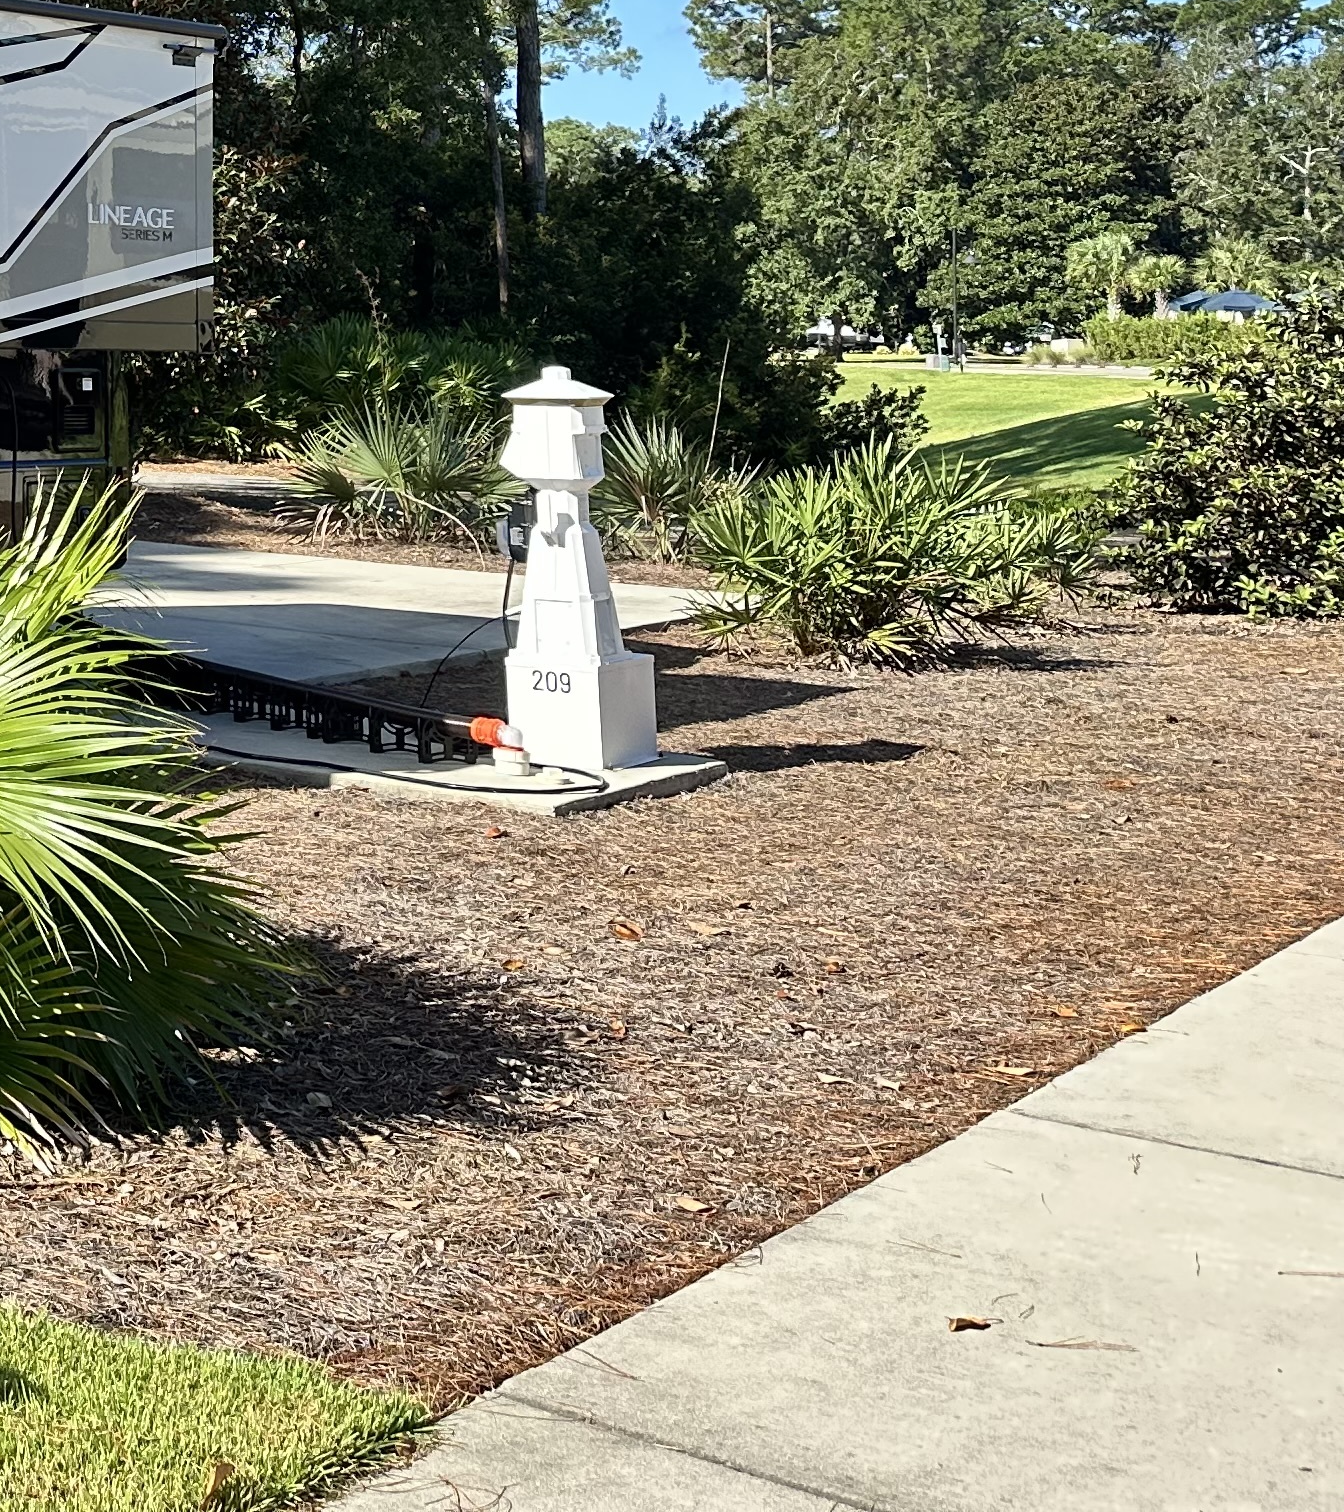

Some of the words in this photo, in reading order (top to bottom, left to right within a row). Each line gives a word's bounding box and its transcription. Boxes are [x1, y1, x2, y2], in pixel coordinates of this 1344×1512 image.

[88, 203, 175, 229] LINEAGE
[121, 229, 161, 242] SERIES
[162, 230, 173, 242] M
[532, 669, 571, 694] 209
